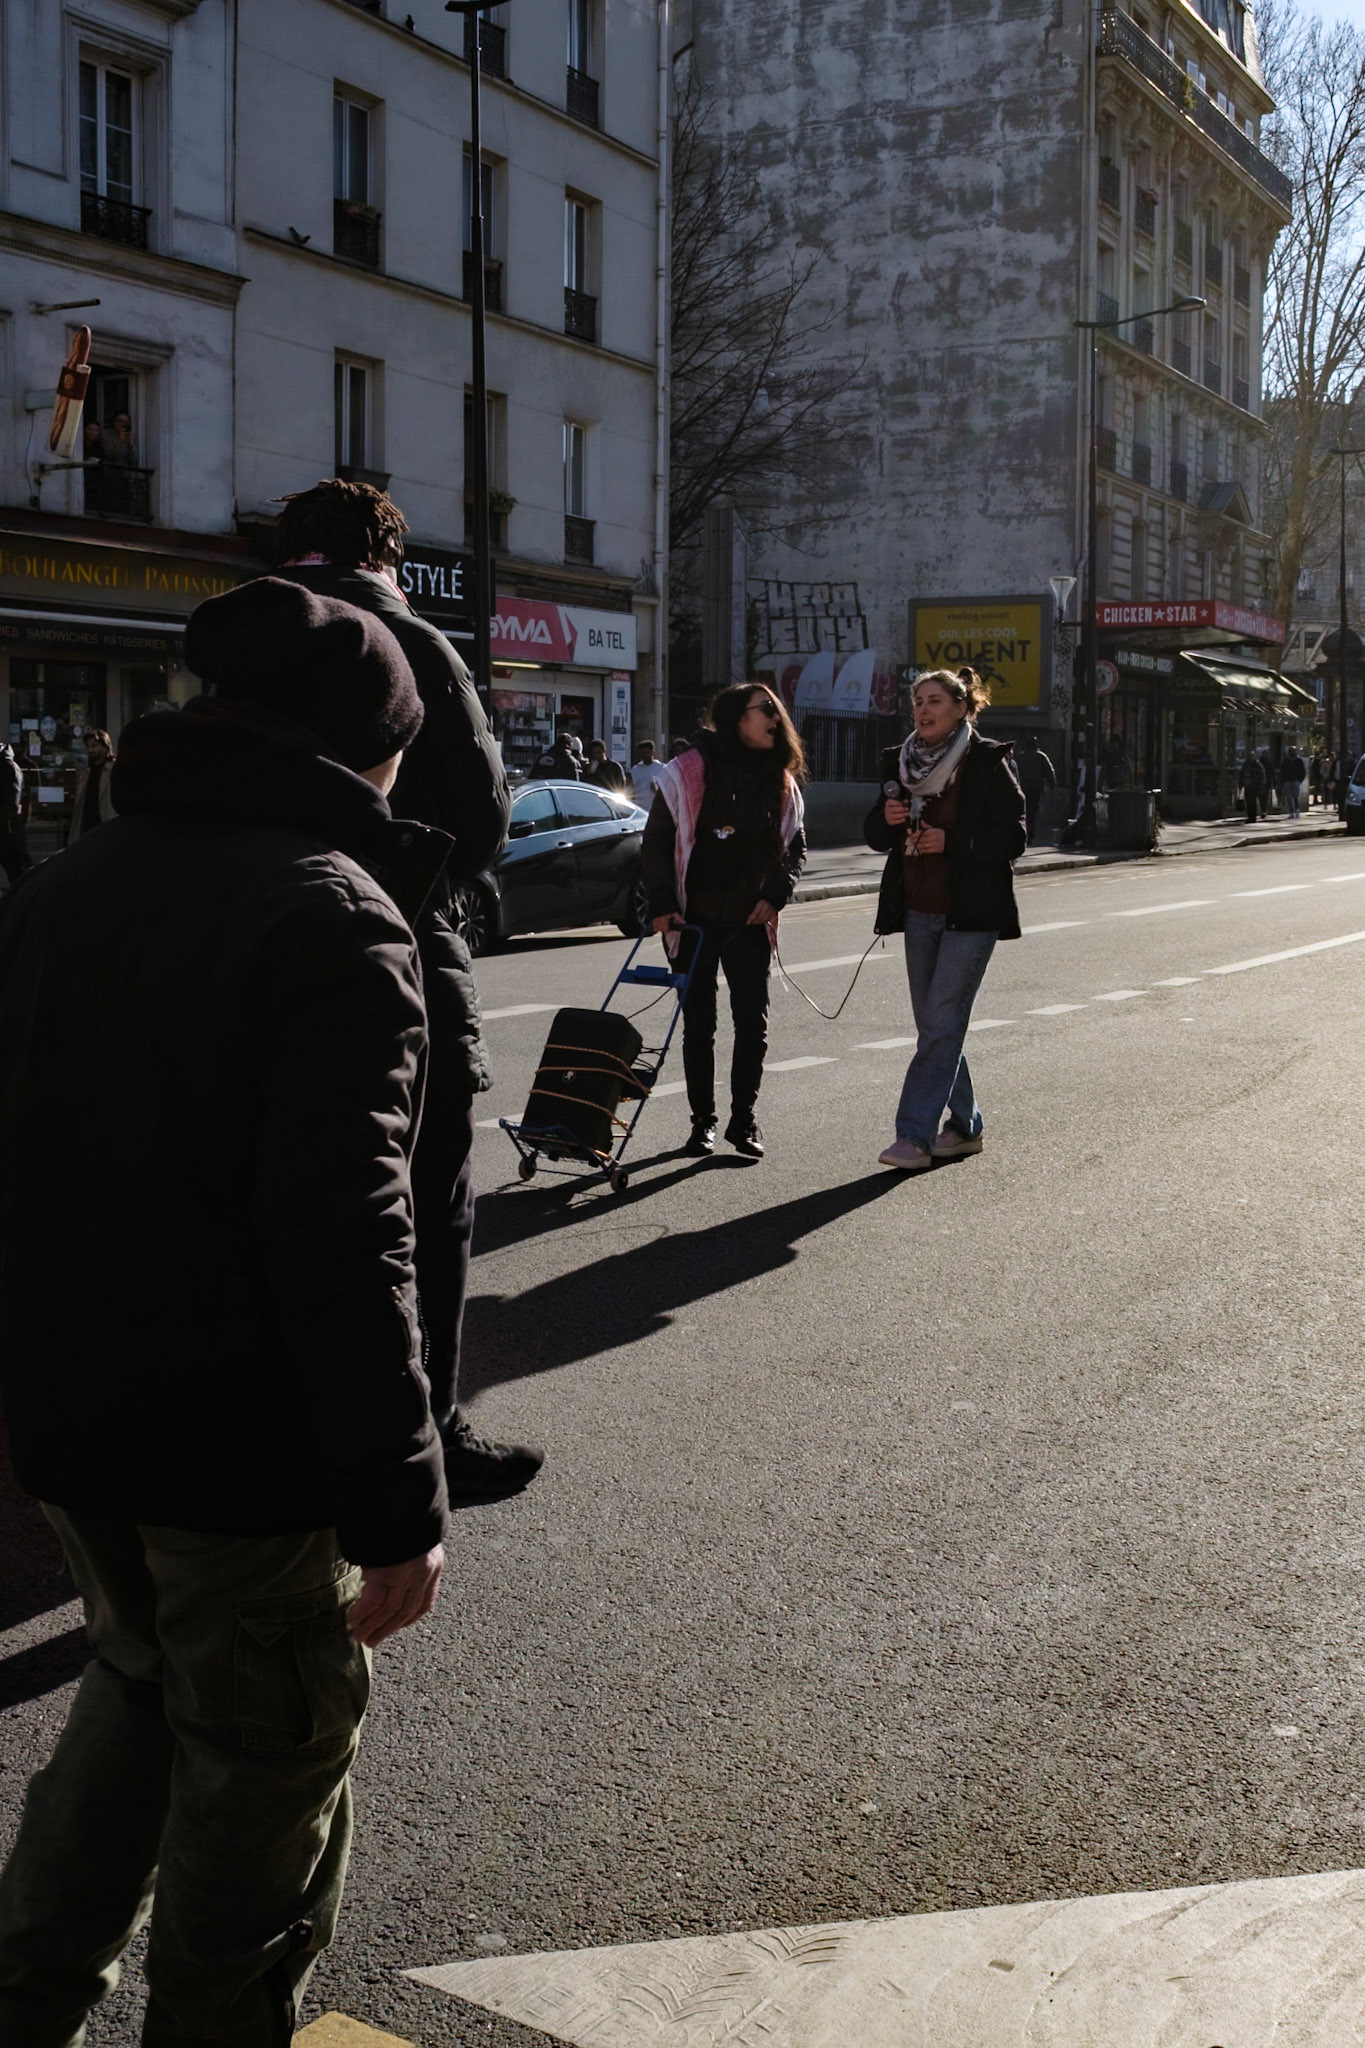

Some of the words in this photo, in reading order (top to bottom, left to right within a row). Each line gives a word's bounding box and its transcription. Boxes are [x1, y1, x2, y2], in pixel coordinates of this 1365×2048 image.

[402, 561, 464, 600] STYLÉ
[1103, 607, 1153, 624] CHICKEN
[1166, 606, 1197, 622] STAR
[25, 628, 98, 645] SANDWICHES
[589, 629, 604, 647] BA
[606, 631, 625, 650] TEL
[964, 628, 982, 639] LES
[985, 627, 1018, 638] COQS
[925, 640, 1031, 663] VOLENT
